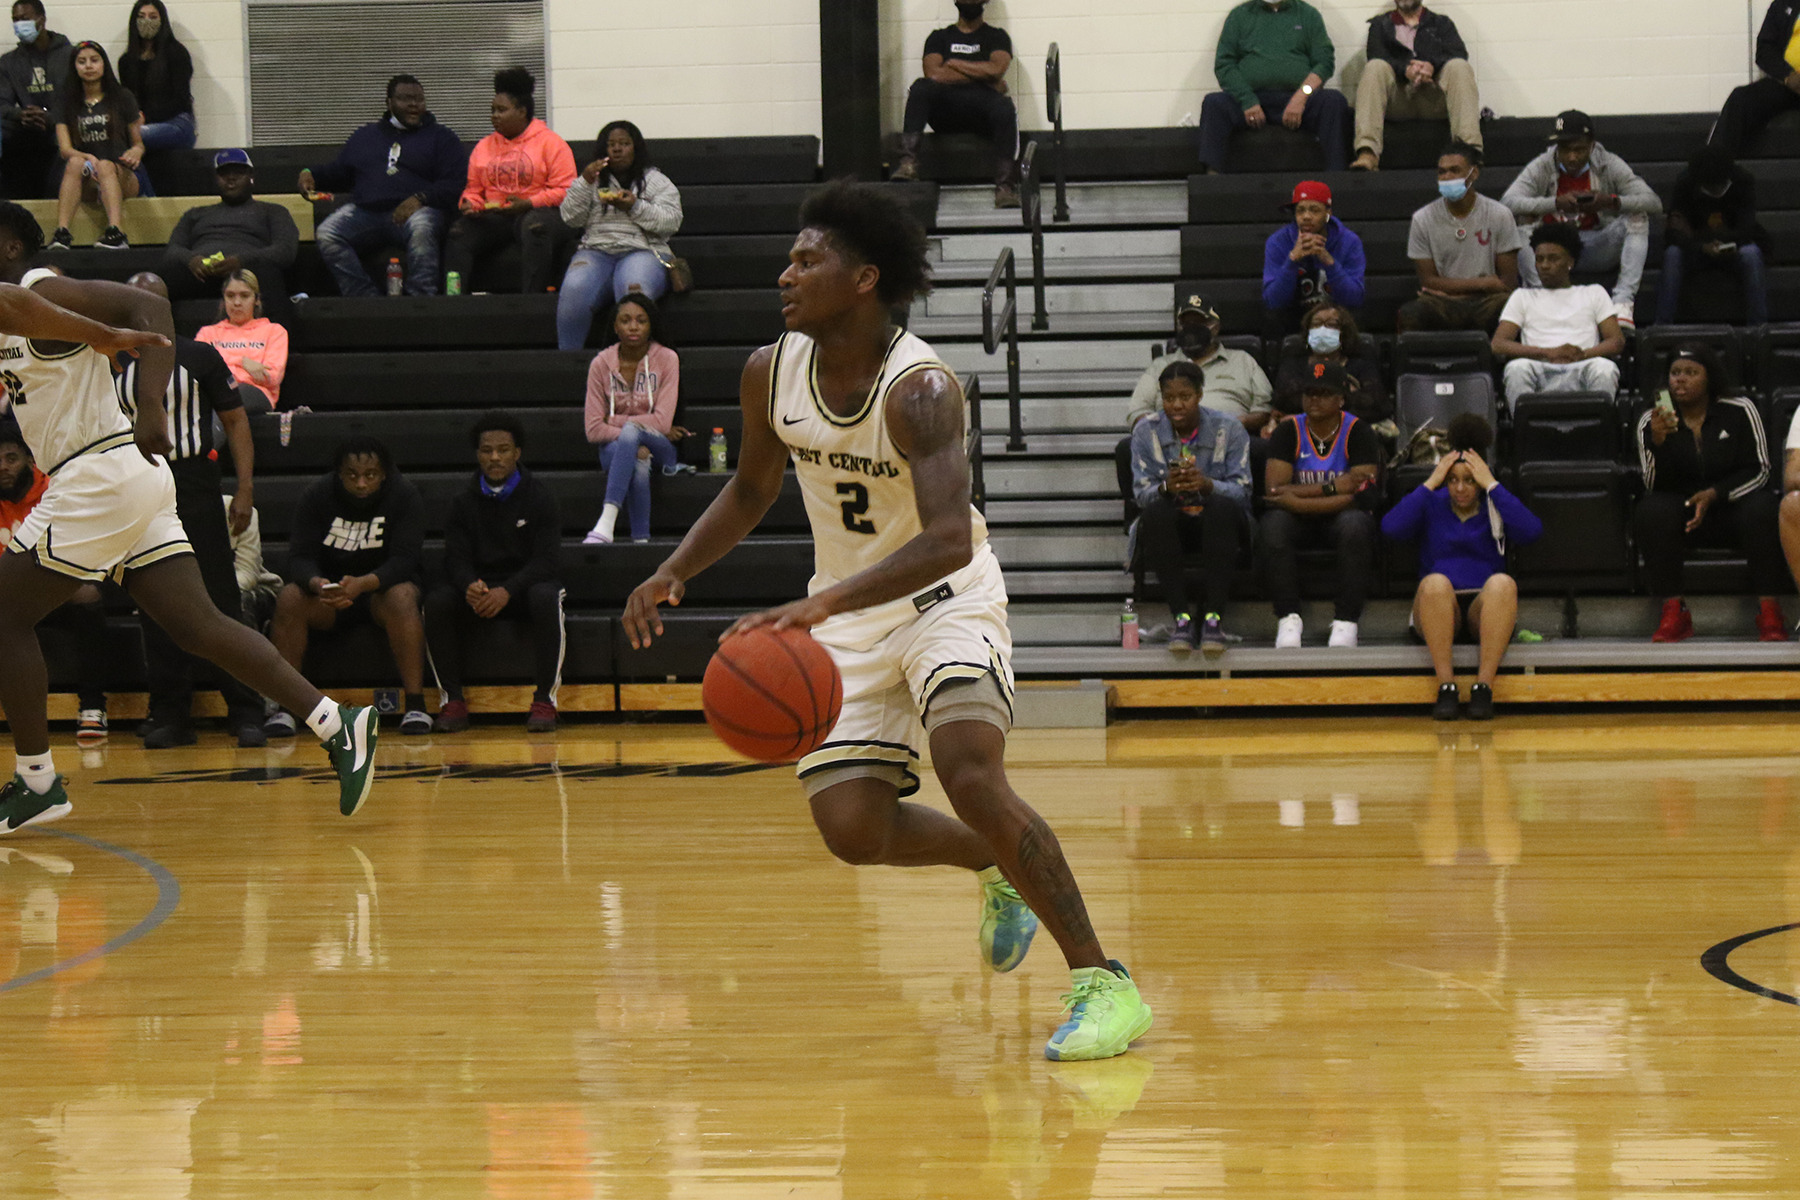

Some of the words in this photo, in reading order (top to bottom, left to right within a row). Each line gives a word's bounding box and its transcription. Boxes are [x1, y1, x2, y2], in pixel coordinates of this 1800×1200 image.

[718, 451, 727, 462] G
[834, 481, 877, 534] 2
[322, 516, 386, 551] NIKE
[940, 589, 949, 598] M
